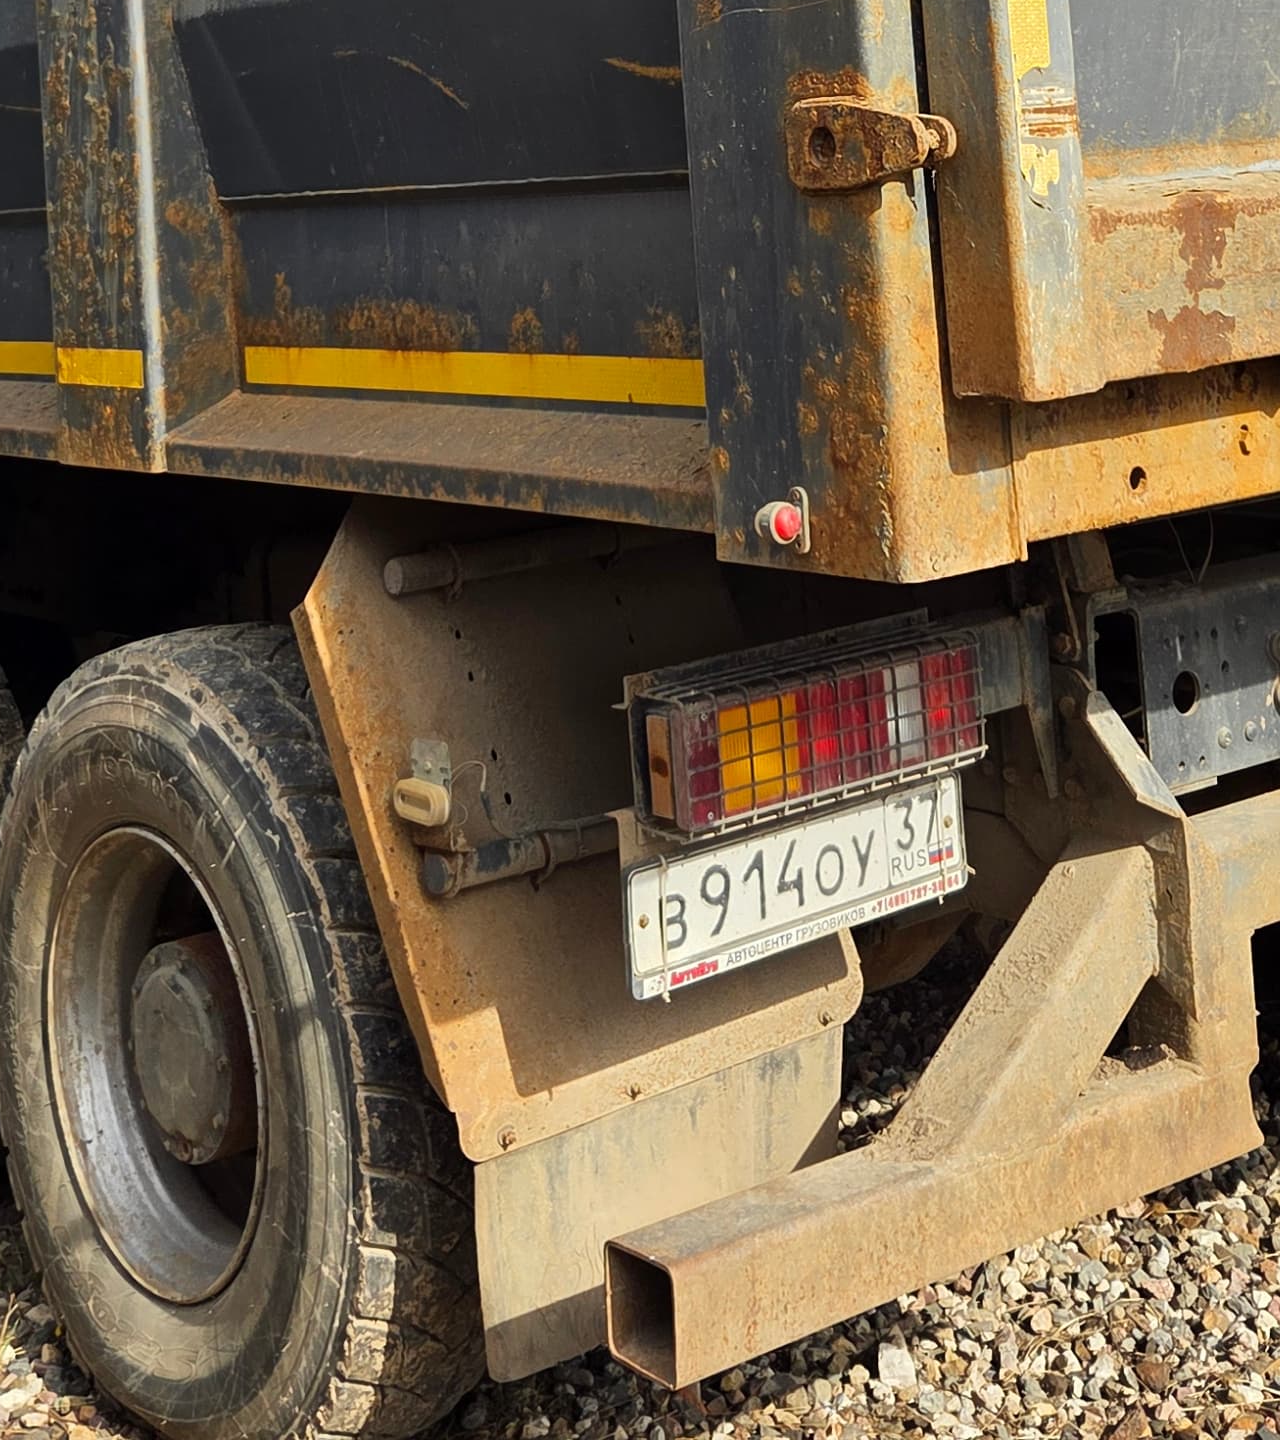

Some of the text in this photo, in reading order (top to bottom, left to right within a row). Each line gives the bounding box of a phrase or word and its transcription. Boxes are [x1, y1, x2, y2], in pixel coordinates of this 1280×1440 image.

[894, 789, 938, 851] 37
[890, 848, 927, 878] RUS
[726, 931, 793, 967] АВТОЦЕНТР
[795, 907, 866, 942] ГРУЗОВИКОВ
